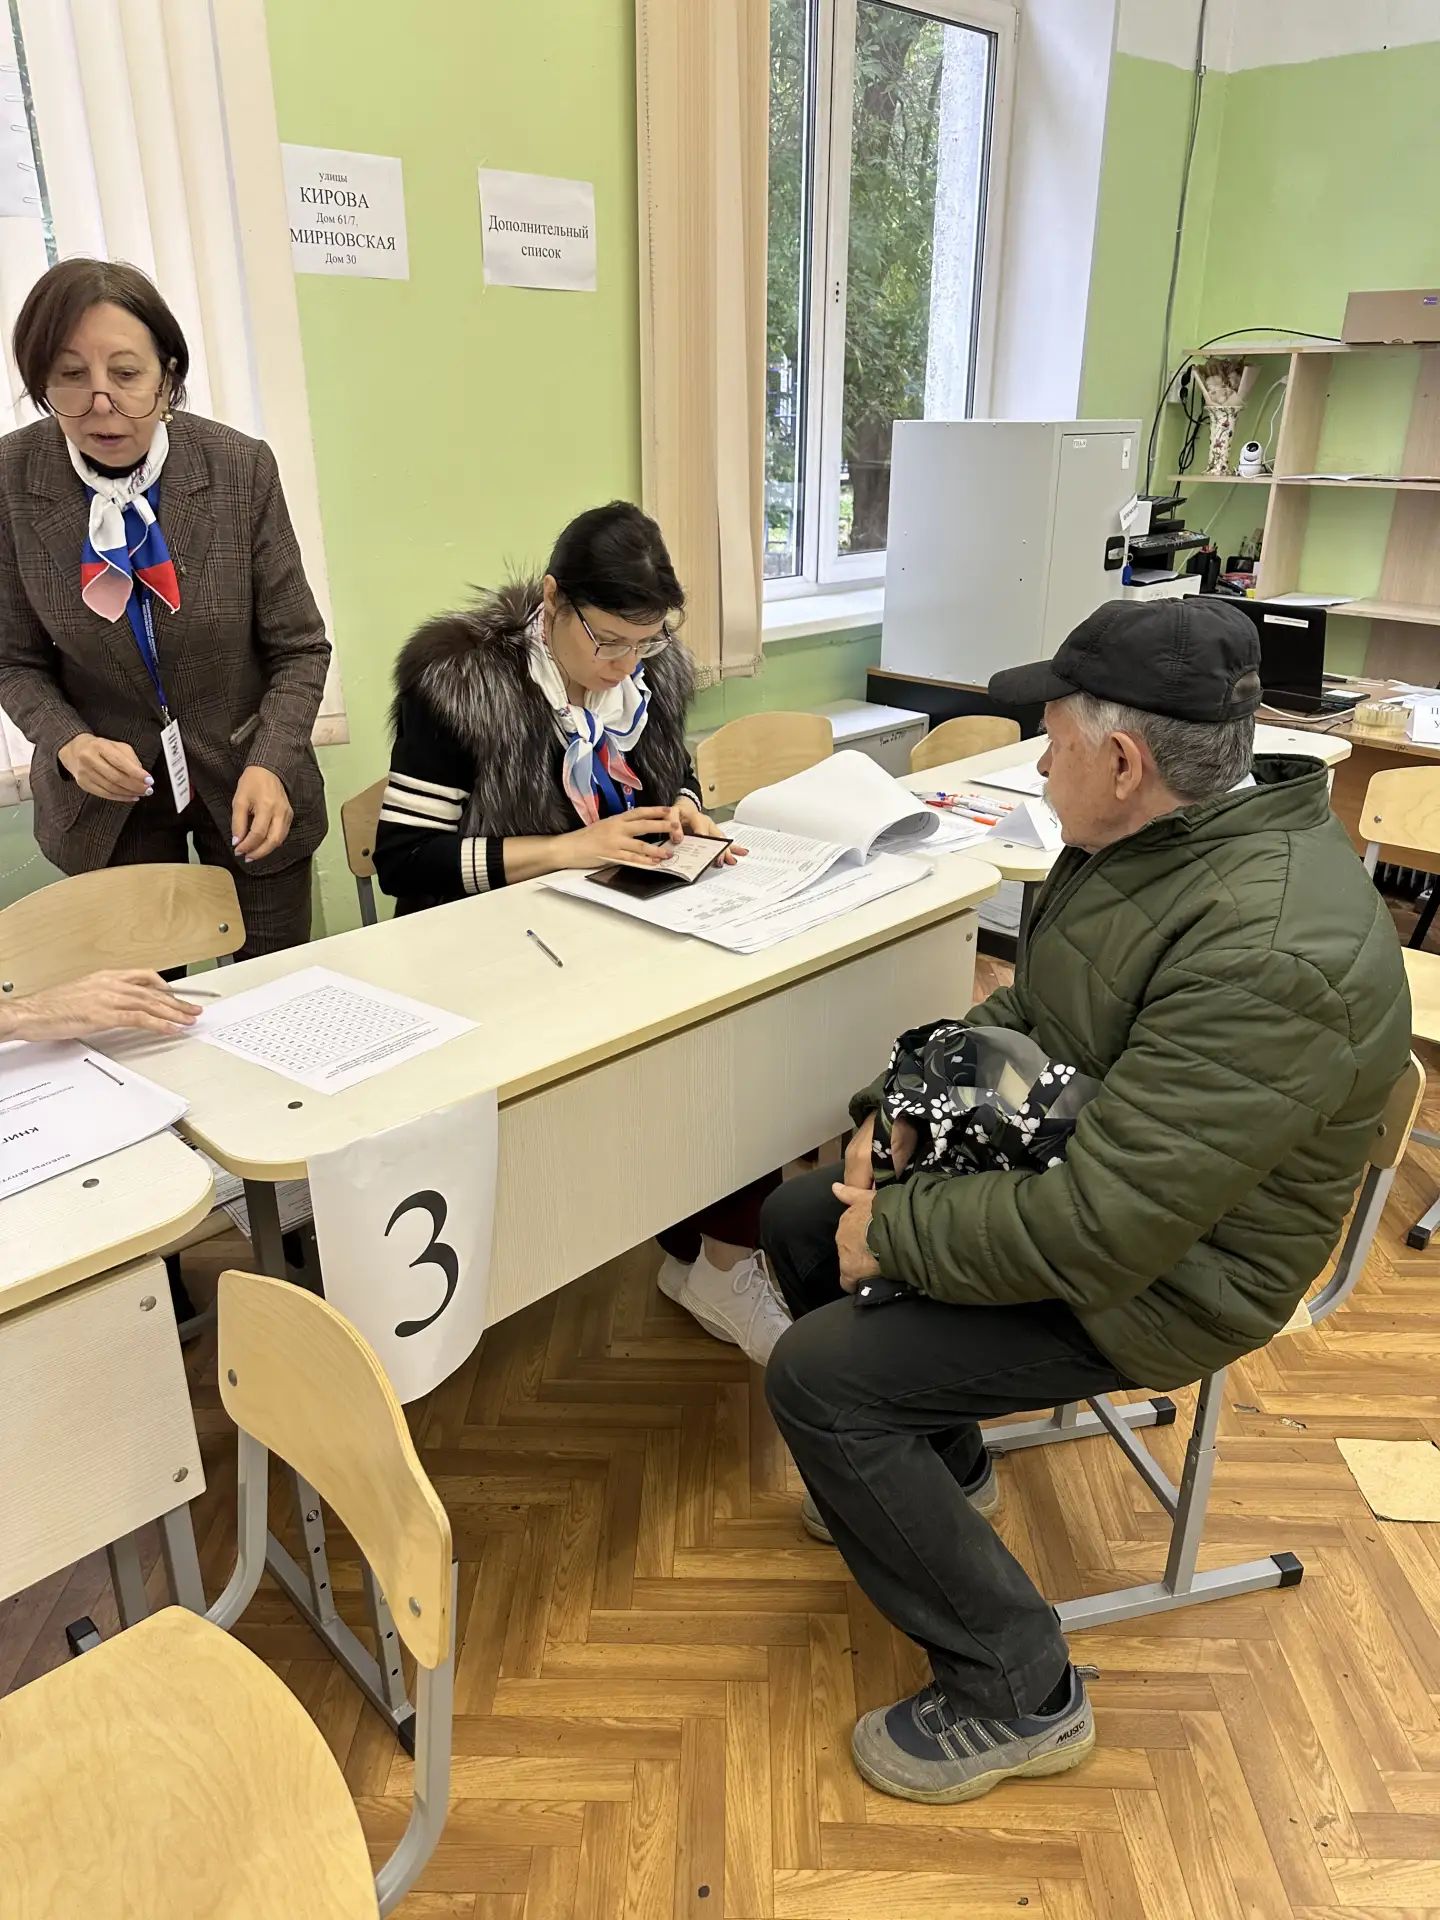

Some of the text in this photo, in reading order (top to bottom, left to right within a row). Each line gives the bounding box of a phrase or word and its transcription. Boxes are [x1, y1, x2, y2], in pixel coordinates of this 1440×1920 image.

[319, 172, 348, 183] улицы
[300, 186, 370, 209] КИРОВА
[316, 212, 335, 224] Дом
[488, 214, 589, 239] Дополнительный
[325, 252, 357, 265] Дом 30
[521, 245, 562, 259] список
[384, 1189, 459, 1338] 3
